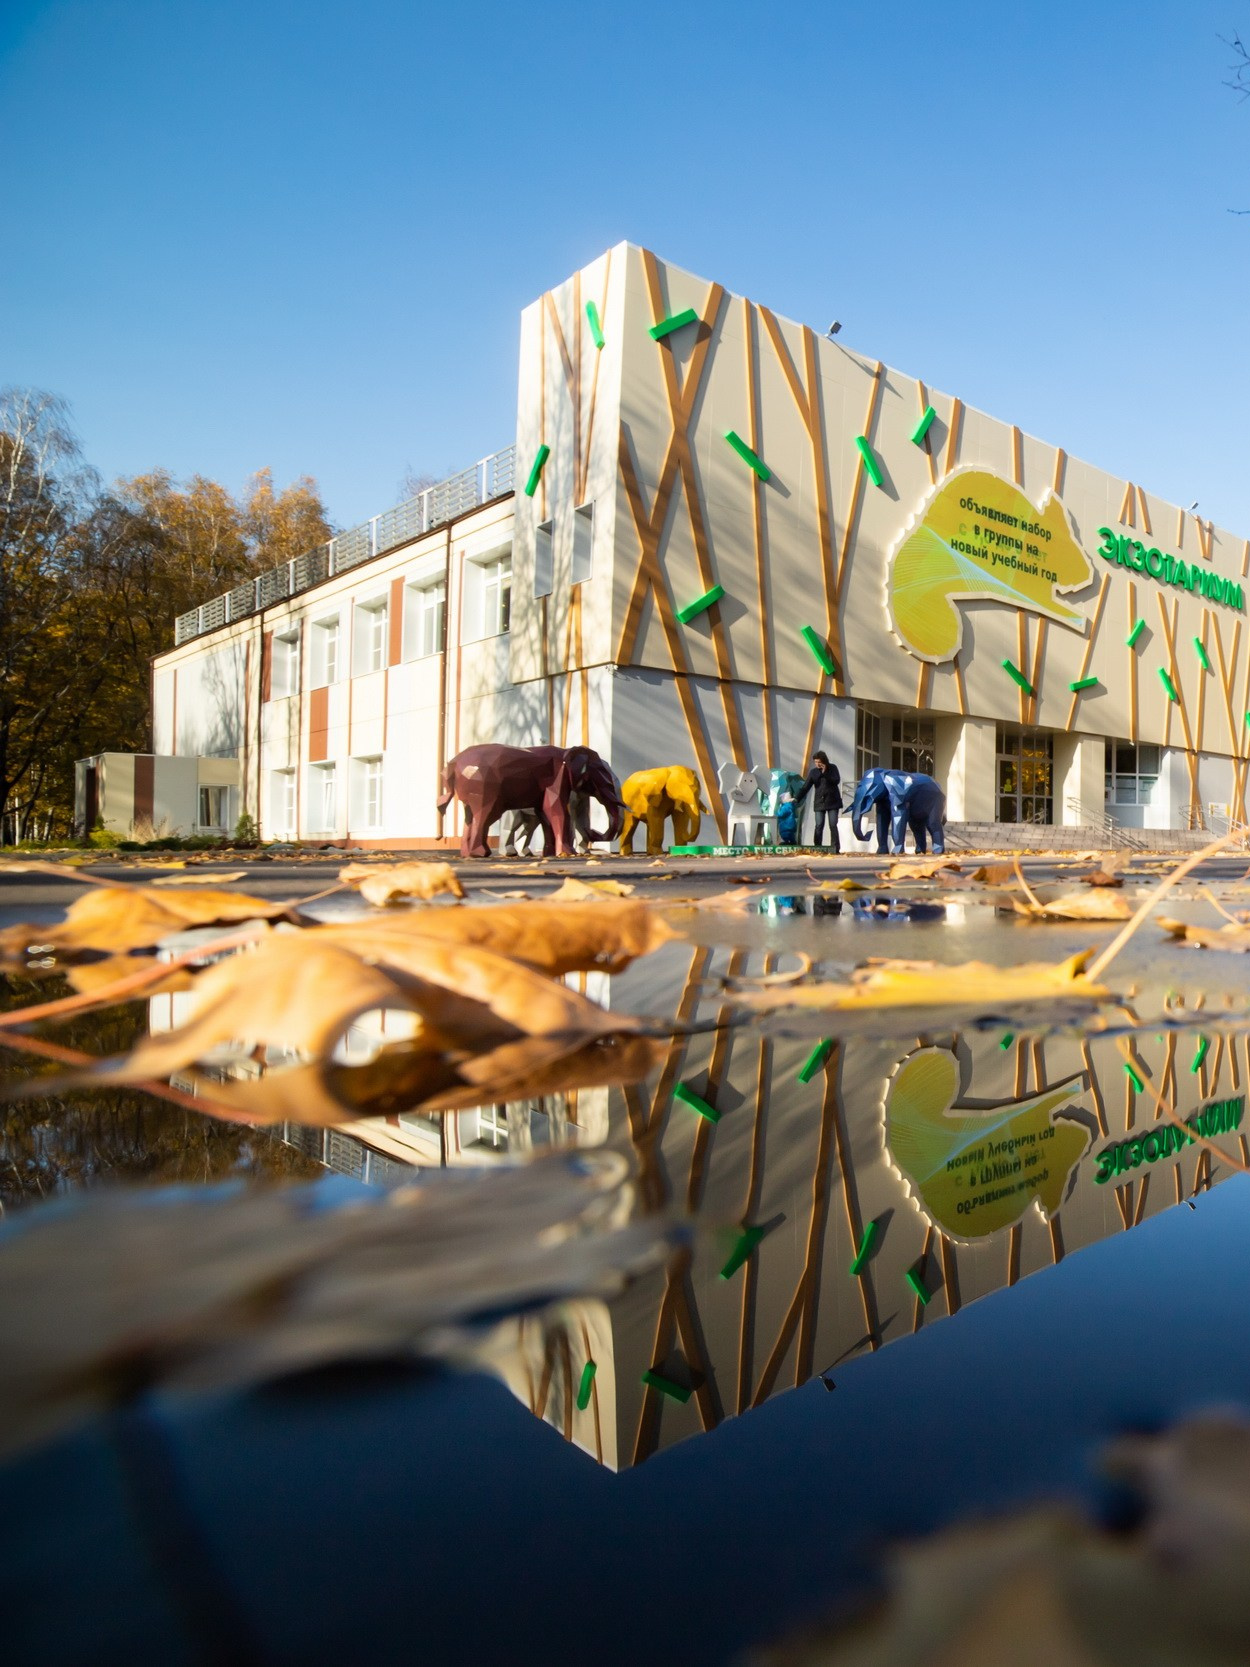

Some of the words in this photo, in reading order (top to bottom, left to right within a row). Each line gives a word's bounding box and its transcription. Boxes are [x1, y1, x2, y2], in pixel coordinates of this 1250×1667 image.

[960, 497, 1018, 528] объявляет
[1021, 520, 1052, 542] набор
[974, 524, 981, 535] в
[984, 528, 1023, 550] группы
[1026, 541, 1039, 556] на
[951, 538, 988, 558] новый
[992, 550, 1038, 575] учебный
[1041, 569, 1058, 583] год
[1097, 527, 1243, 611] ЭКЗОТАРИУМ
